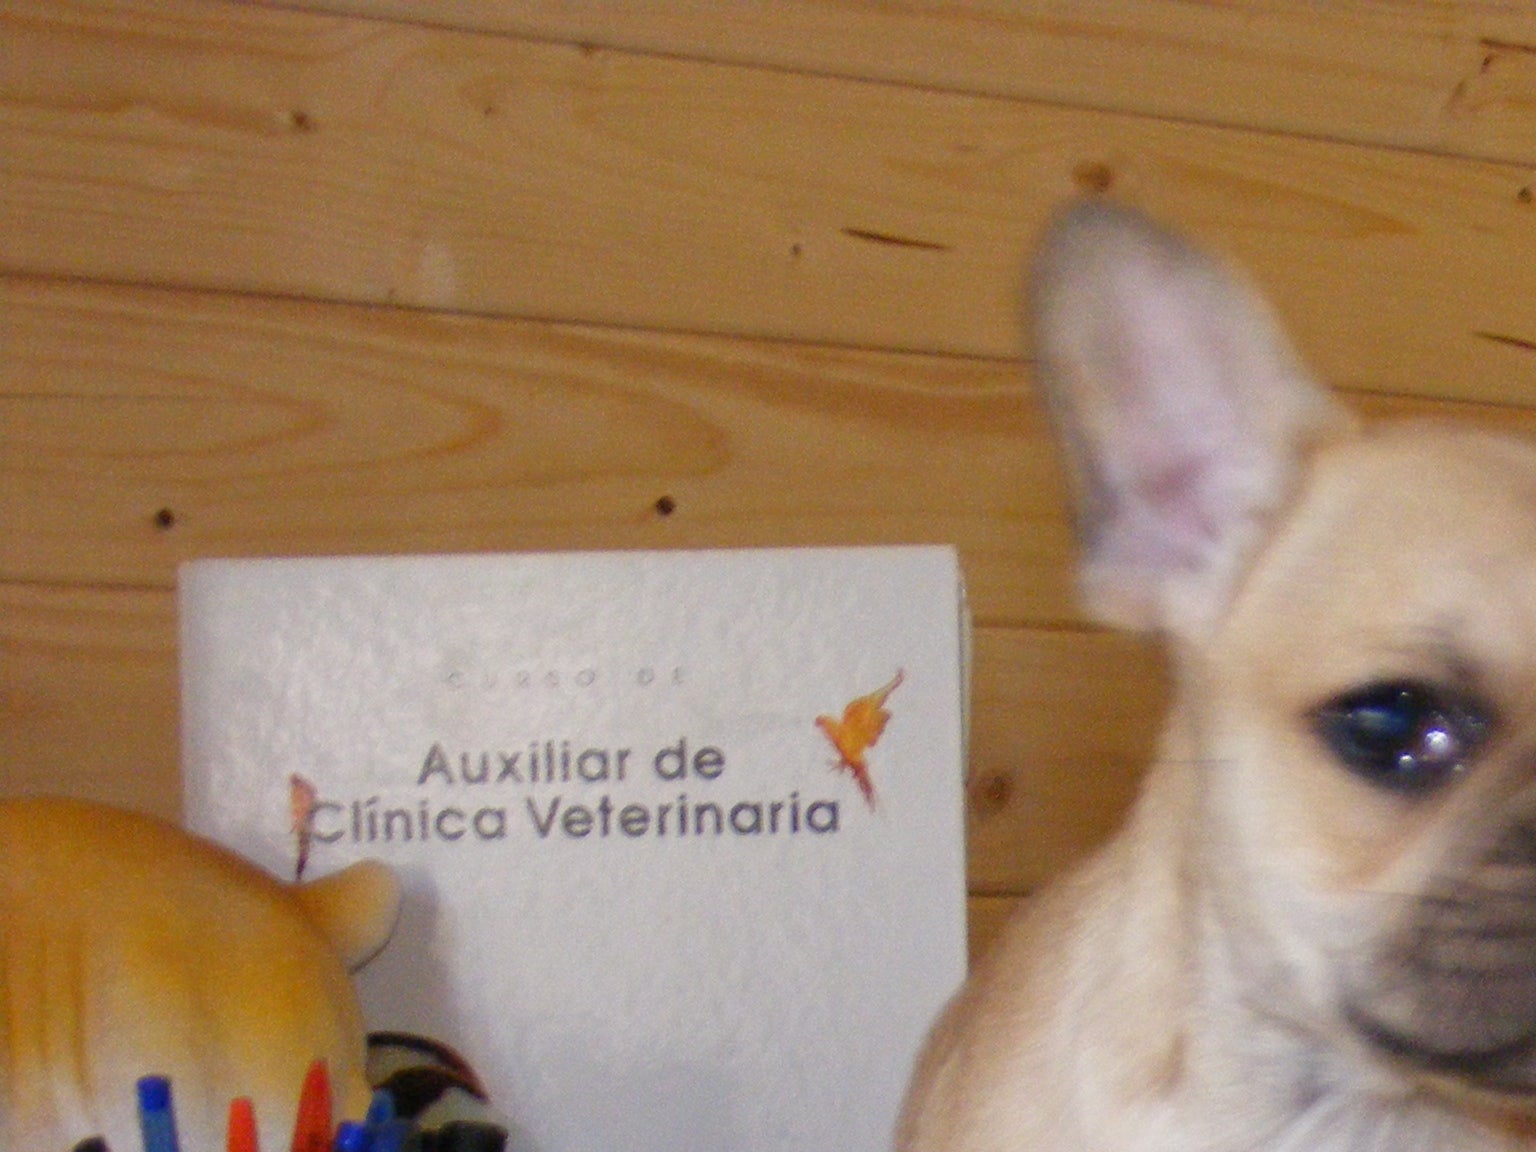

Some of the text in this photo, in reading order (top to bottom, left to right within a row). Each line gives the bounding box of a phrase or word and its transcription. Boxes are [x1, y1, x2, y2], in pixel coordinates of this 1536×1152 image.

[418, 737, 725, 785] Auxiliar de
[309, 791, 840, 842] Clínica Veterinaria
